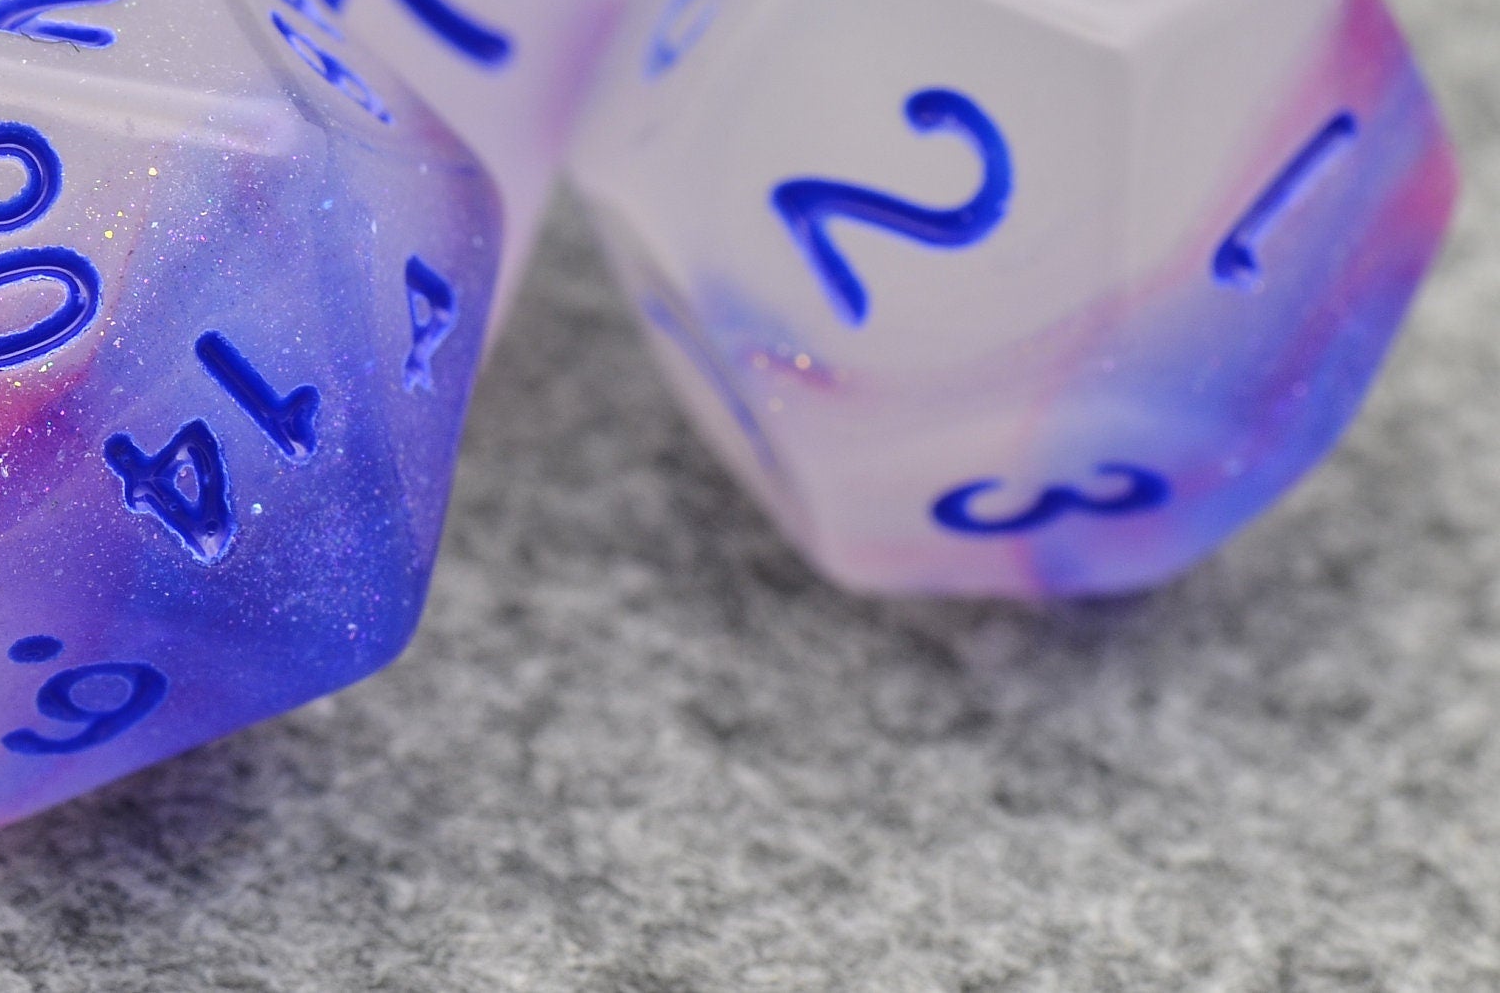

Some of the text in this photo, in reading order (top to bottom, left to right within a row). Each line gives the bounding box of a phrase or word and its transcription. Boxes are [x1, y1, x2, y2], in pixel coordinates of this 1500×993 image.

[768, 86, 1016, 328] 2
[1209, 109, 1358, 287] 1
[103, 328, 323, 568] 14
[929, 461, 1172, 537] 3
